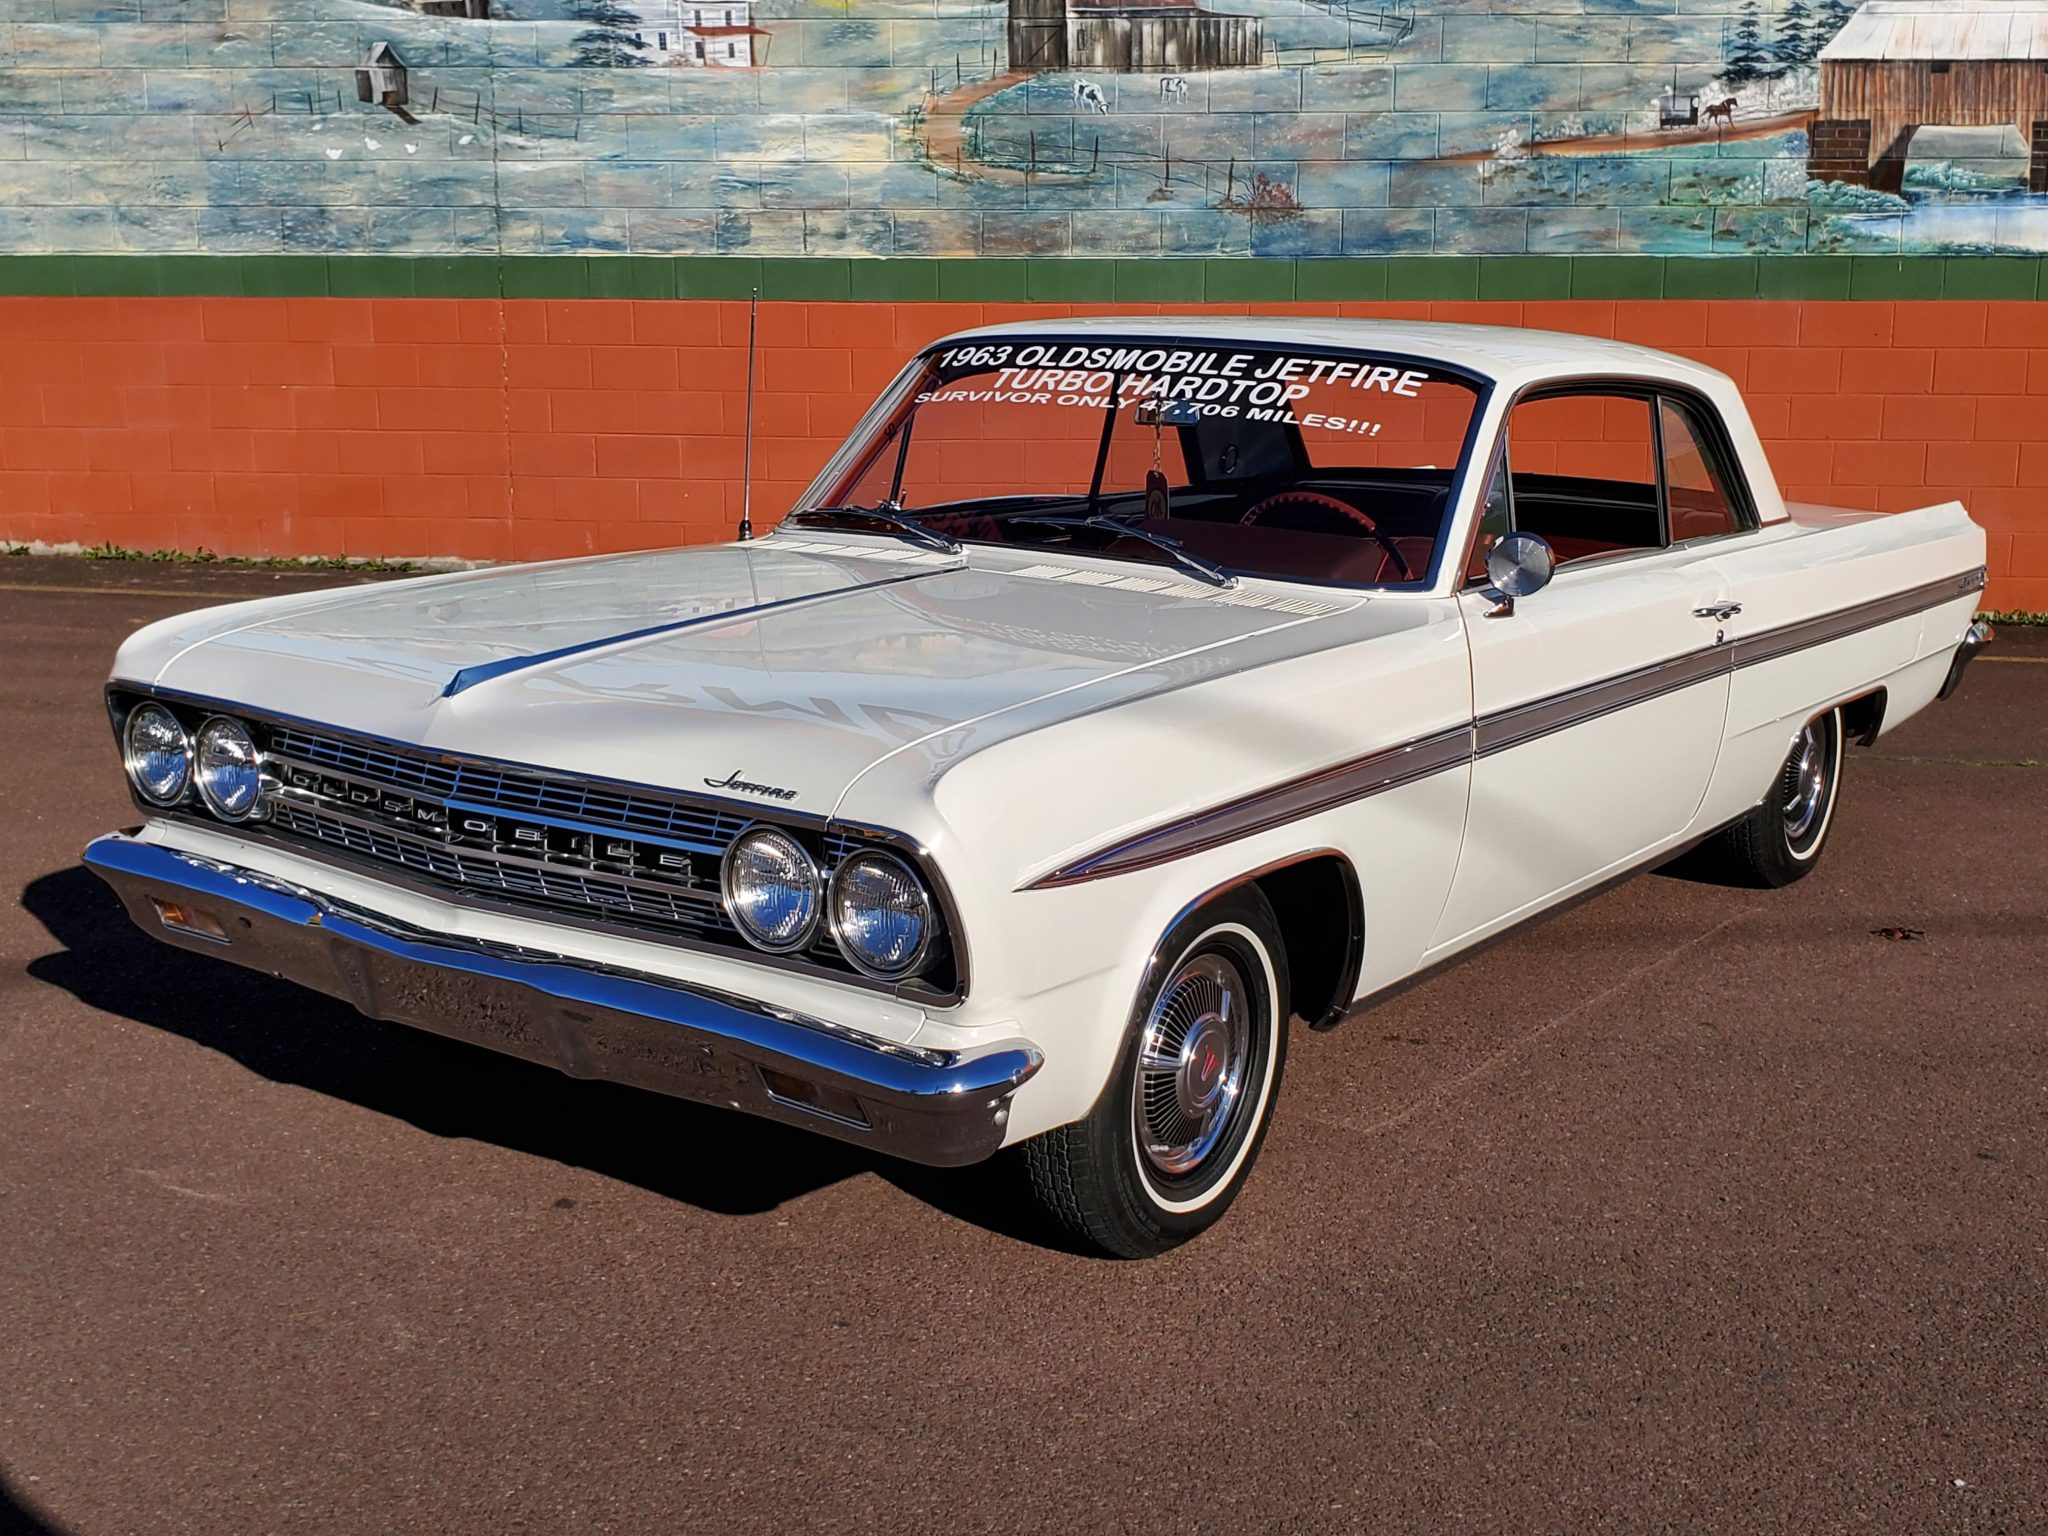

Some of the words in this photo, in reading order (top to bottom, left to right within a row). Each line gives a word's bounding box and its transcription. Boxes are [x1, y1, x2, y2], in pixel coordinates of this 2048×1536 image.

[940, 346, 1013, 368] 1963
[1015, 346, 1254, 376] OLDSMOBILE
[1254, 357, 1429, 397] JETFIRE
[994, 368, 1115, 394] TURBO
[1116, 373, 1309, 407] HARDTOP
[914, 391, 1051, 405] SURVIVOR
[1057, 395, 1136, 409] ONLY
[1139, 399, 1240, 417] 47,706
[1246, 408, 1381, 437] MILES!!!
[292, 773, 686, 868] OLDSMOBILE
